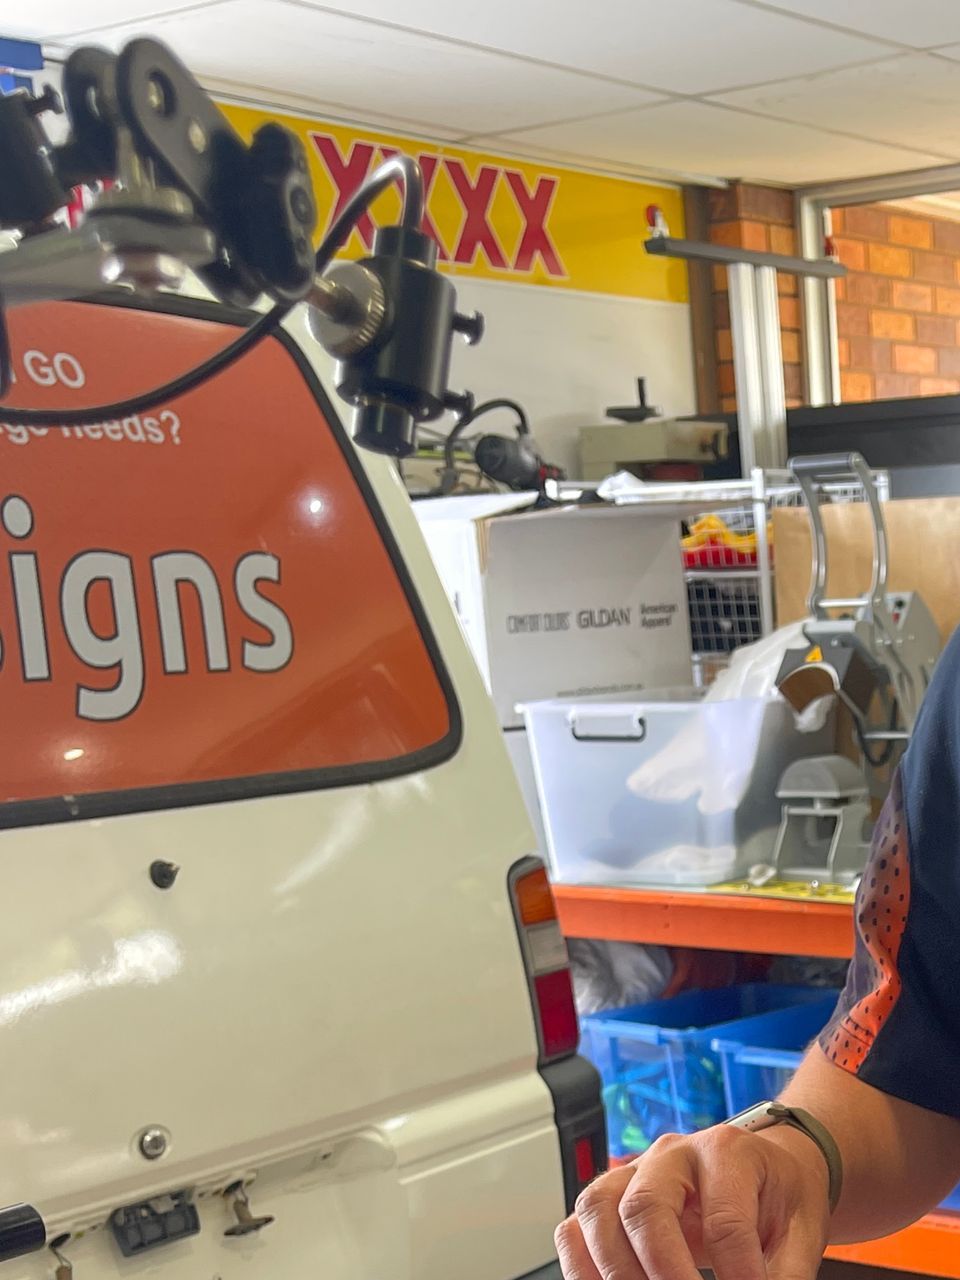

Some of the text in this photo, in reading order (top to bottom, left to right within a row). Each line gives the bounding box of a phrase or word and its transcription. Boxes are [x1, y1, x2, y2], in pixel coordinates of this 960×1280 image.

[308, 130, 570, 279] XXXX
[23, 350, 86, 389] GO
[0, 494, 295, 723] igns
[576, 607, 632, 630] GILDAN
